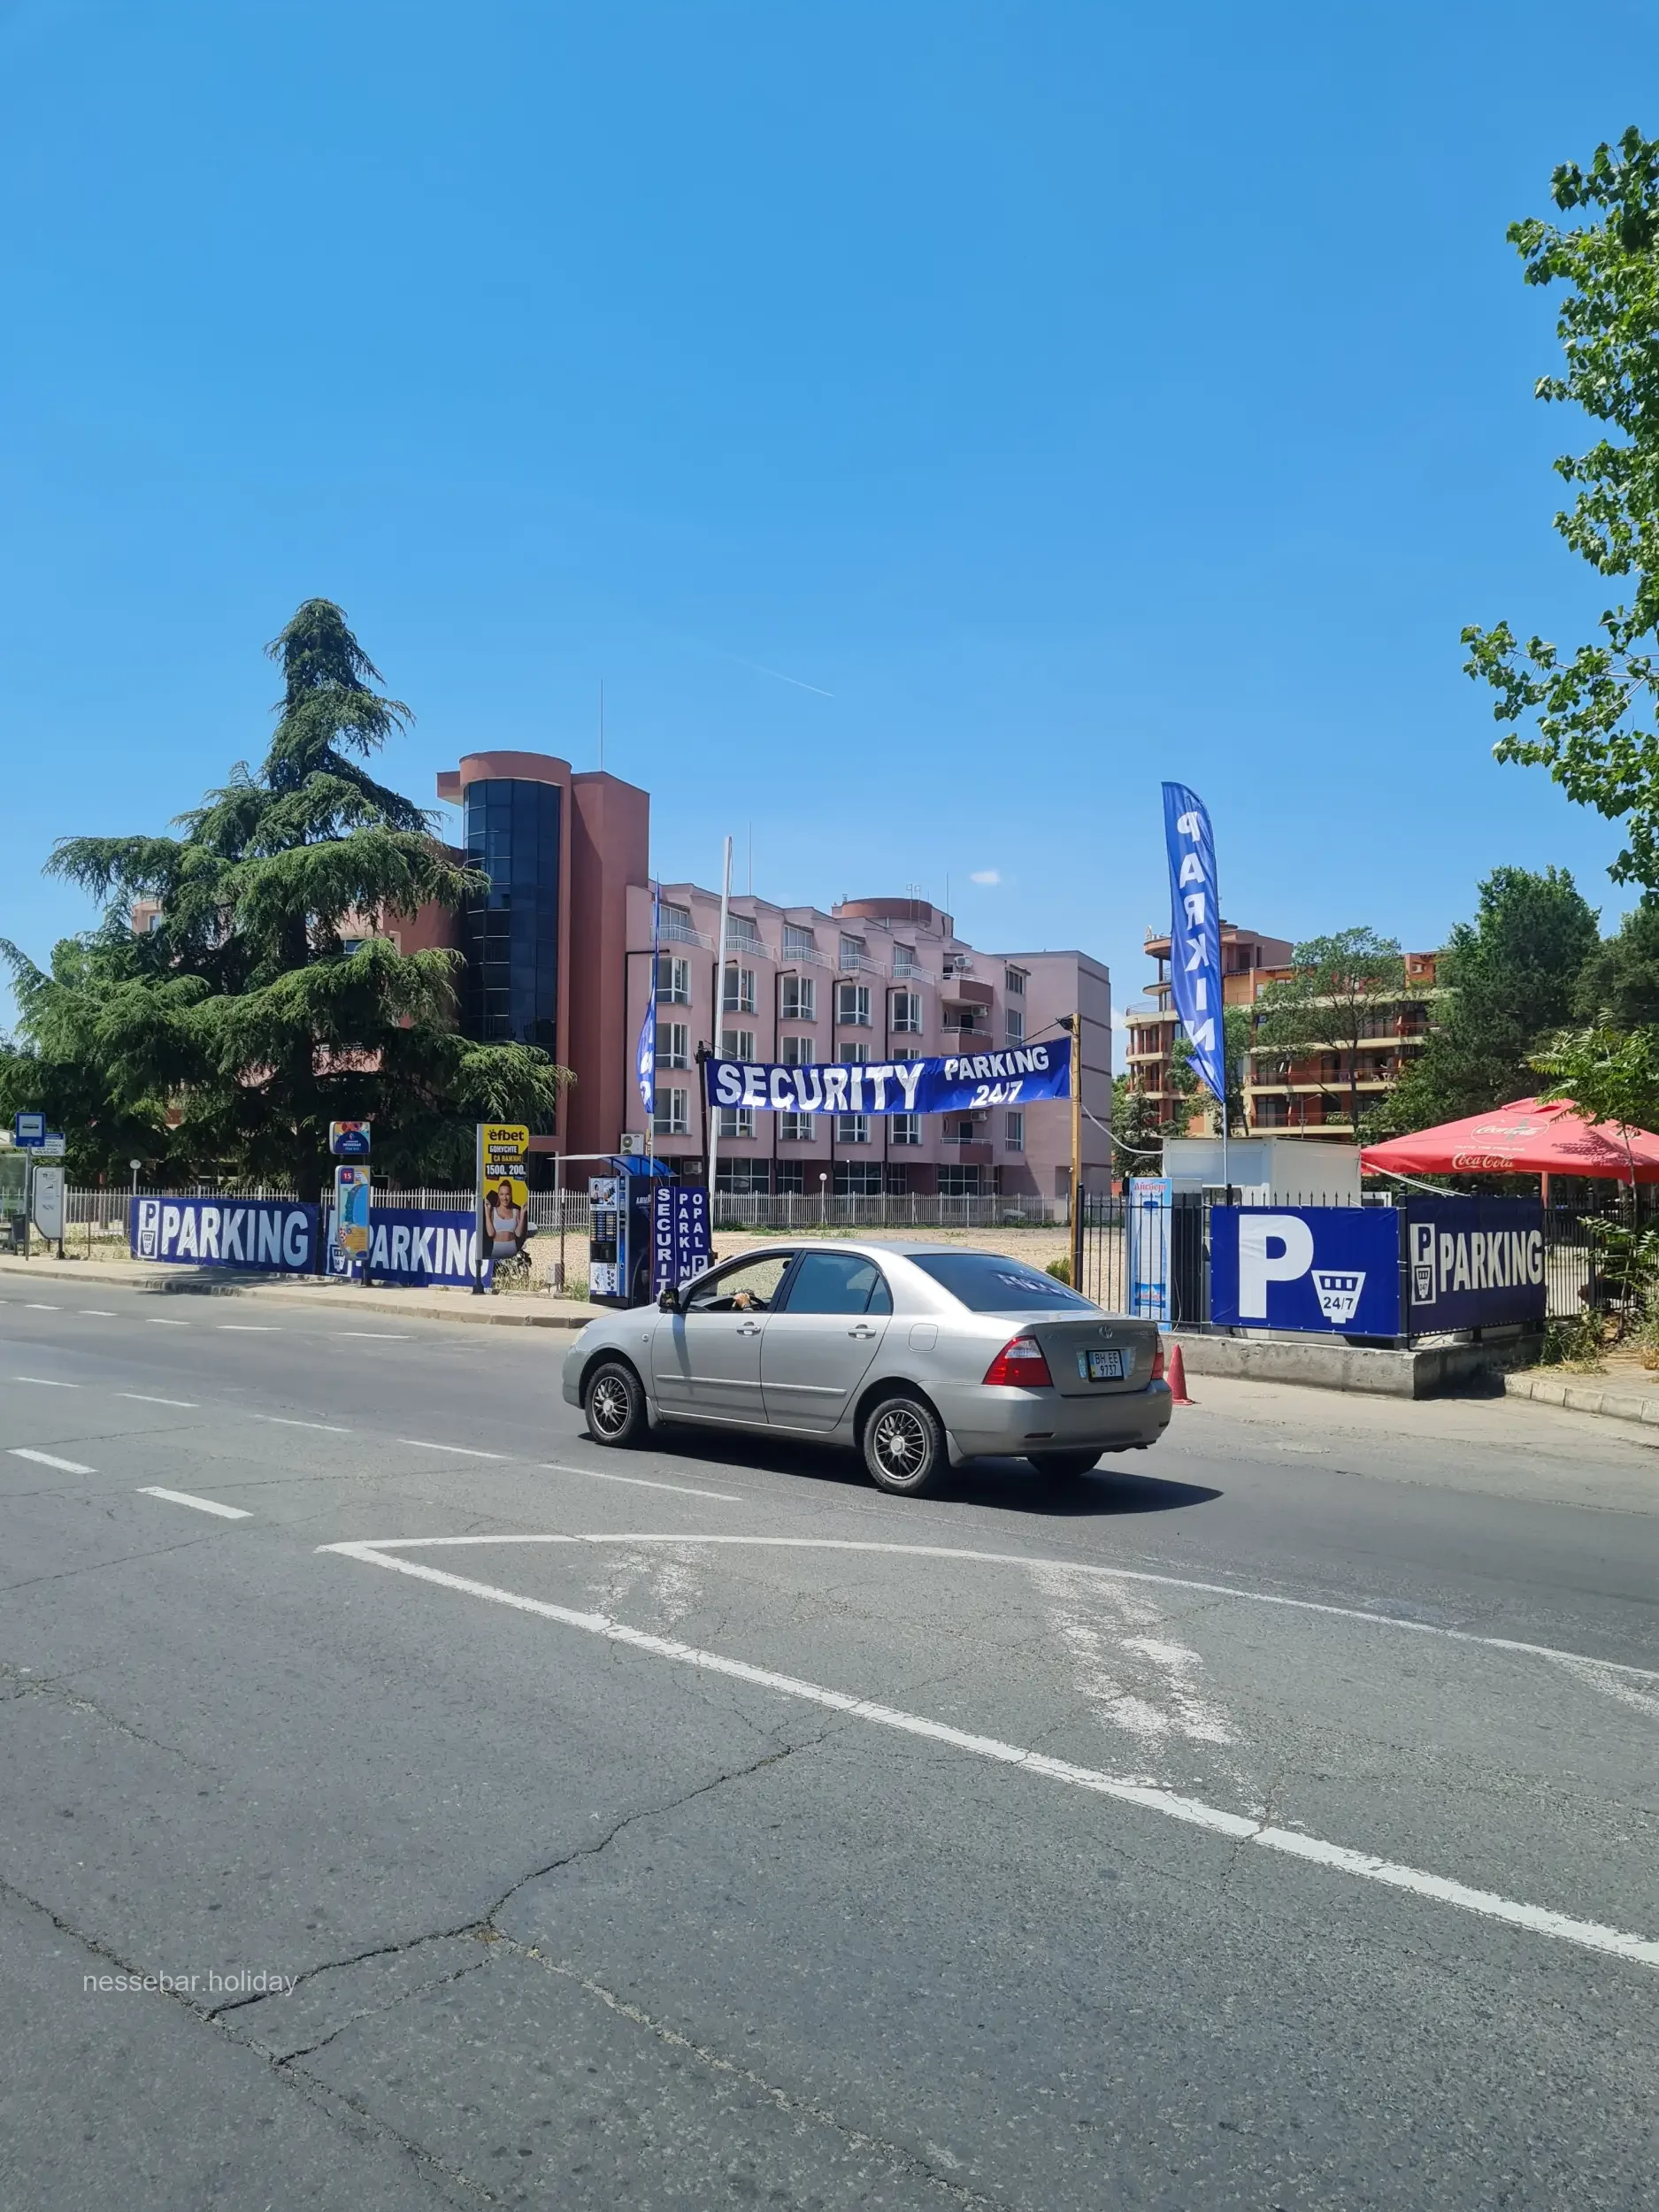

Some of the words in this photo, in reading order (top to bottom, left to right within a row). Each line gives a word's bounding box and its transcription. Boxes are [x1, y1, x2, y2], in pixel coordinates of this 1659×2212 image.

[943, 1046, 1049, 1081] PARKING
[717, 1064, 925, 1112] SECURITY
[972, 1080, 1023, 1107] 24/7
[488, 1129, 525, 1141] efbet
[1452, 1153, 1515, 1170] Coca-Cola
[145, 1203, 157, 1228] P
[692, 1194, 703, 1248] OPAL
[161, 1206, 309, 1267] PARKING
[656, 1188, 672, 1298] SECURIT
[1418, 1226, 1432, 1262] P
[1239, 1214, 1314, 1319] P
[1440, 1229, 1543, 1293] PARKING
[1323, 1296, 1354, 1310] 24/7
[1094, 1353, 1106, 1363] BH
[1109, 1353, 1118, 1363] EE
[1100, 1364, 1117, 1376] 9737
